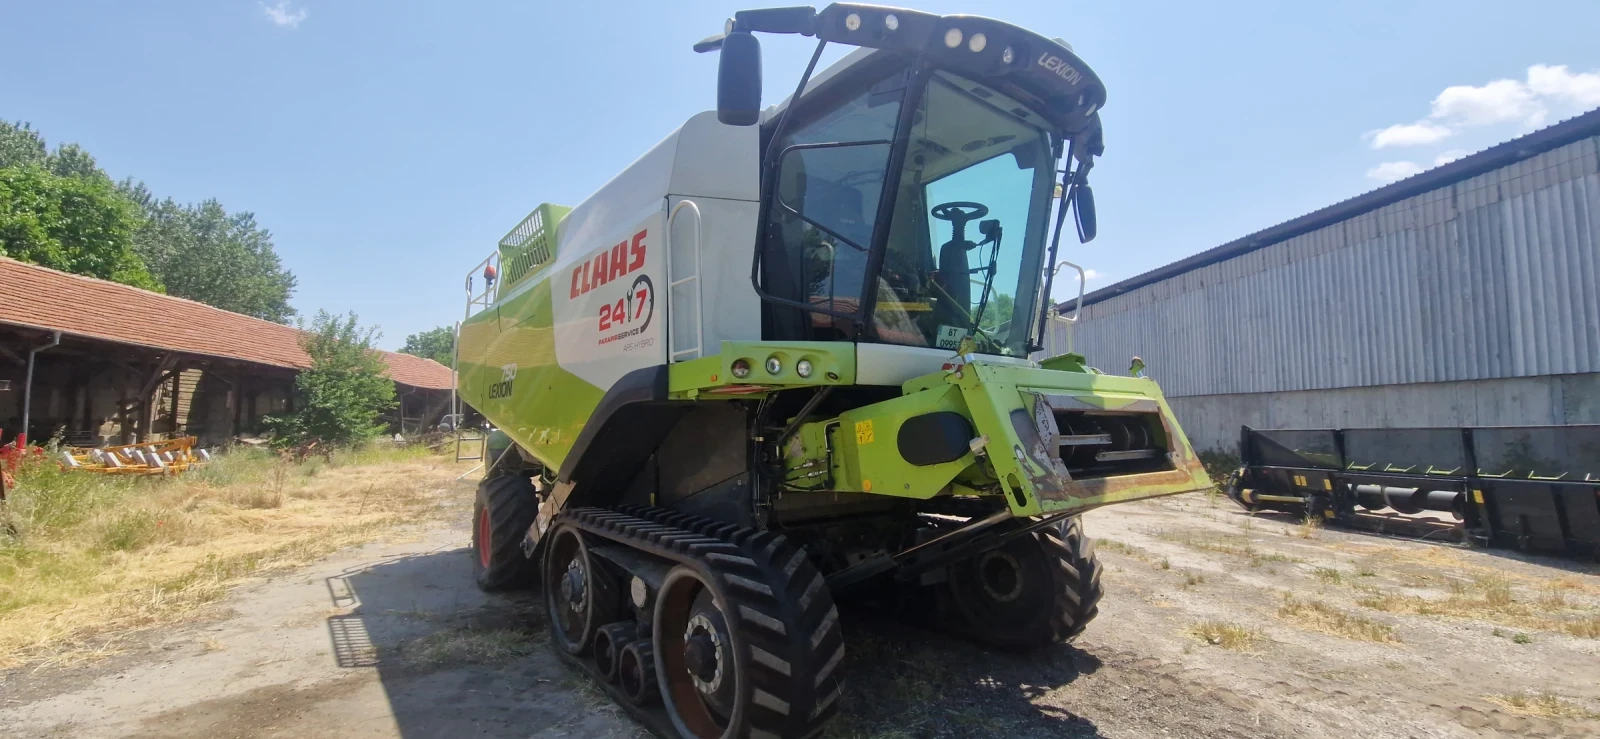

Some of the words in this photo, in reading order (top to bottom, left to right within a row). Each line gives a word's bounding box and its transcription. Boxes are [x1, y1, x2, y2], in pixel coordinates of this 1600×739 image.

[1038, 52, 1083, 86] LEXION
[569, 228, 648, 300] CLAAS
[500, 362, 518, 383] 750
[488, 380, 513, 400] LEXION
